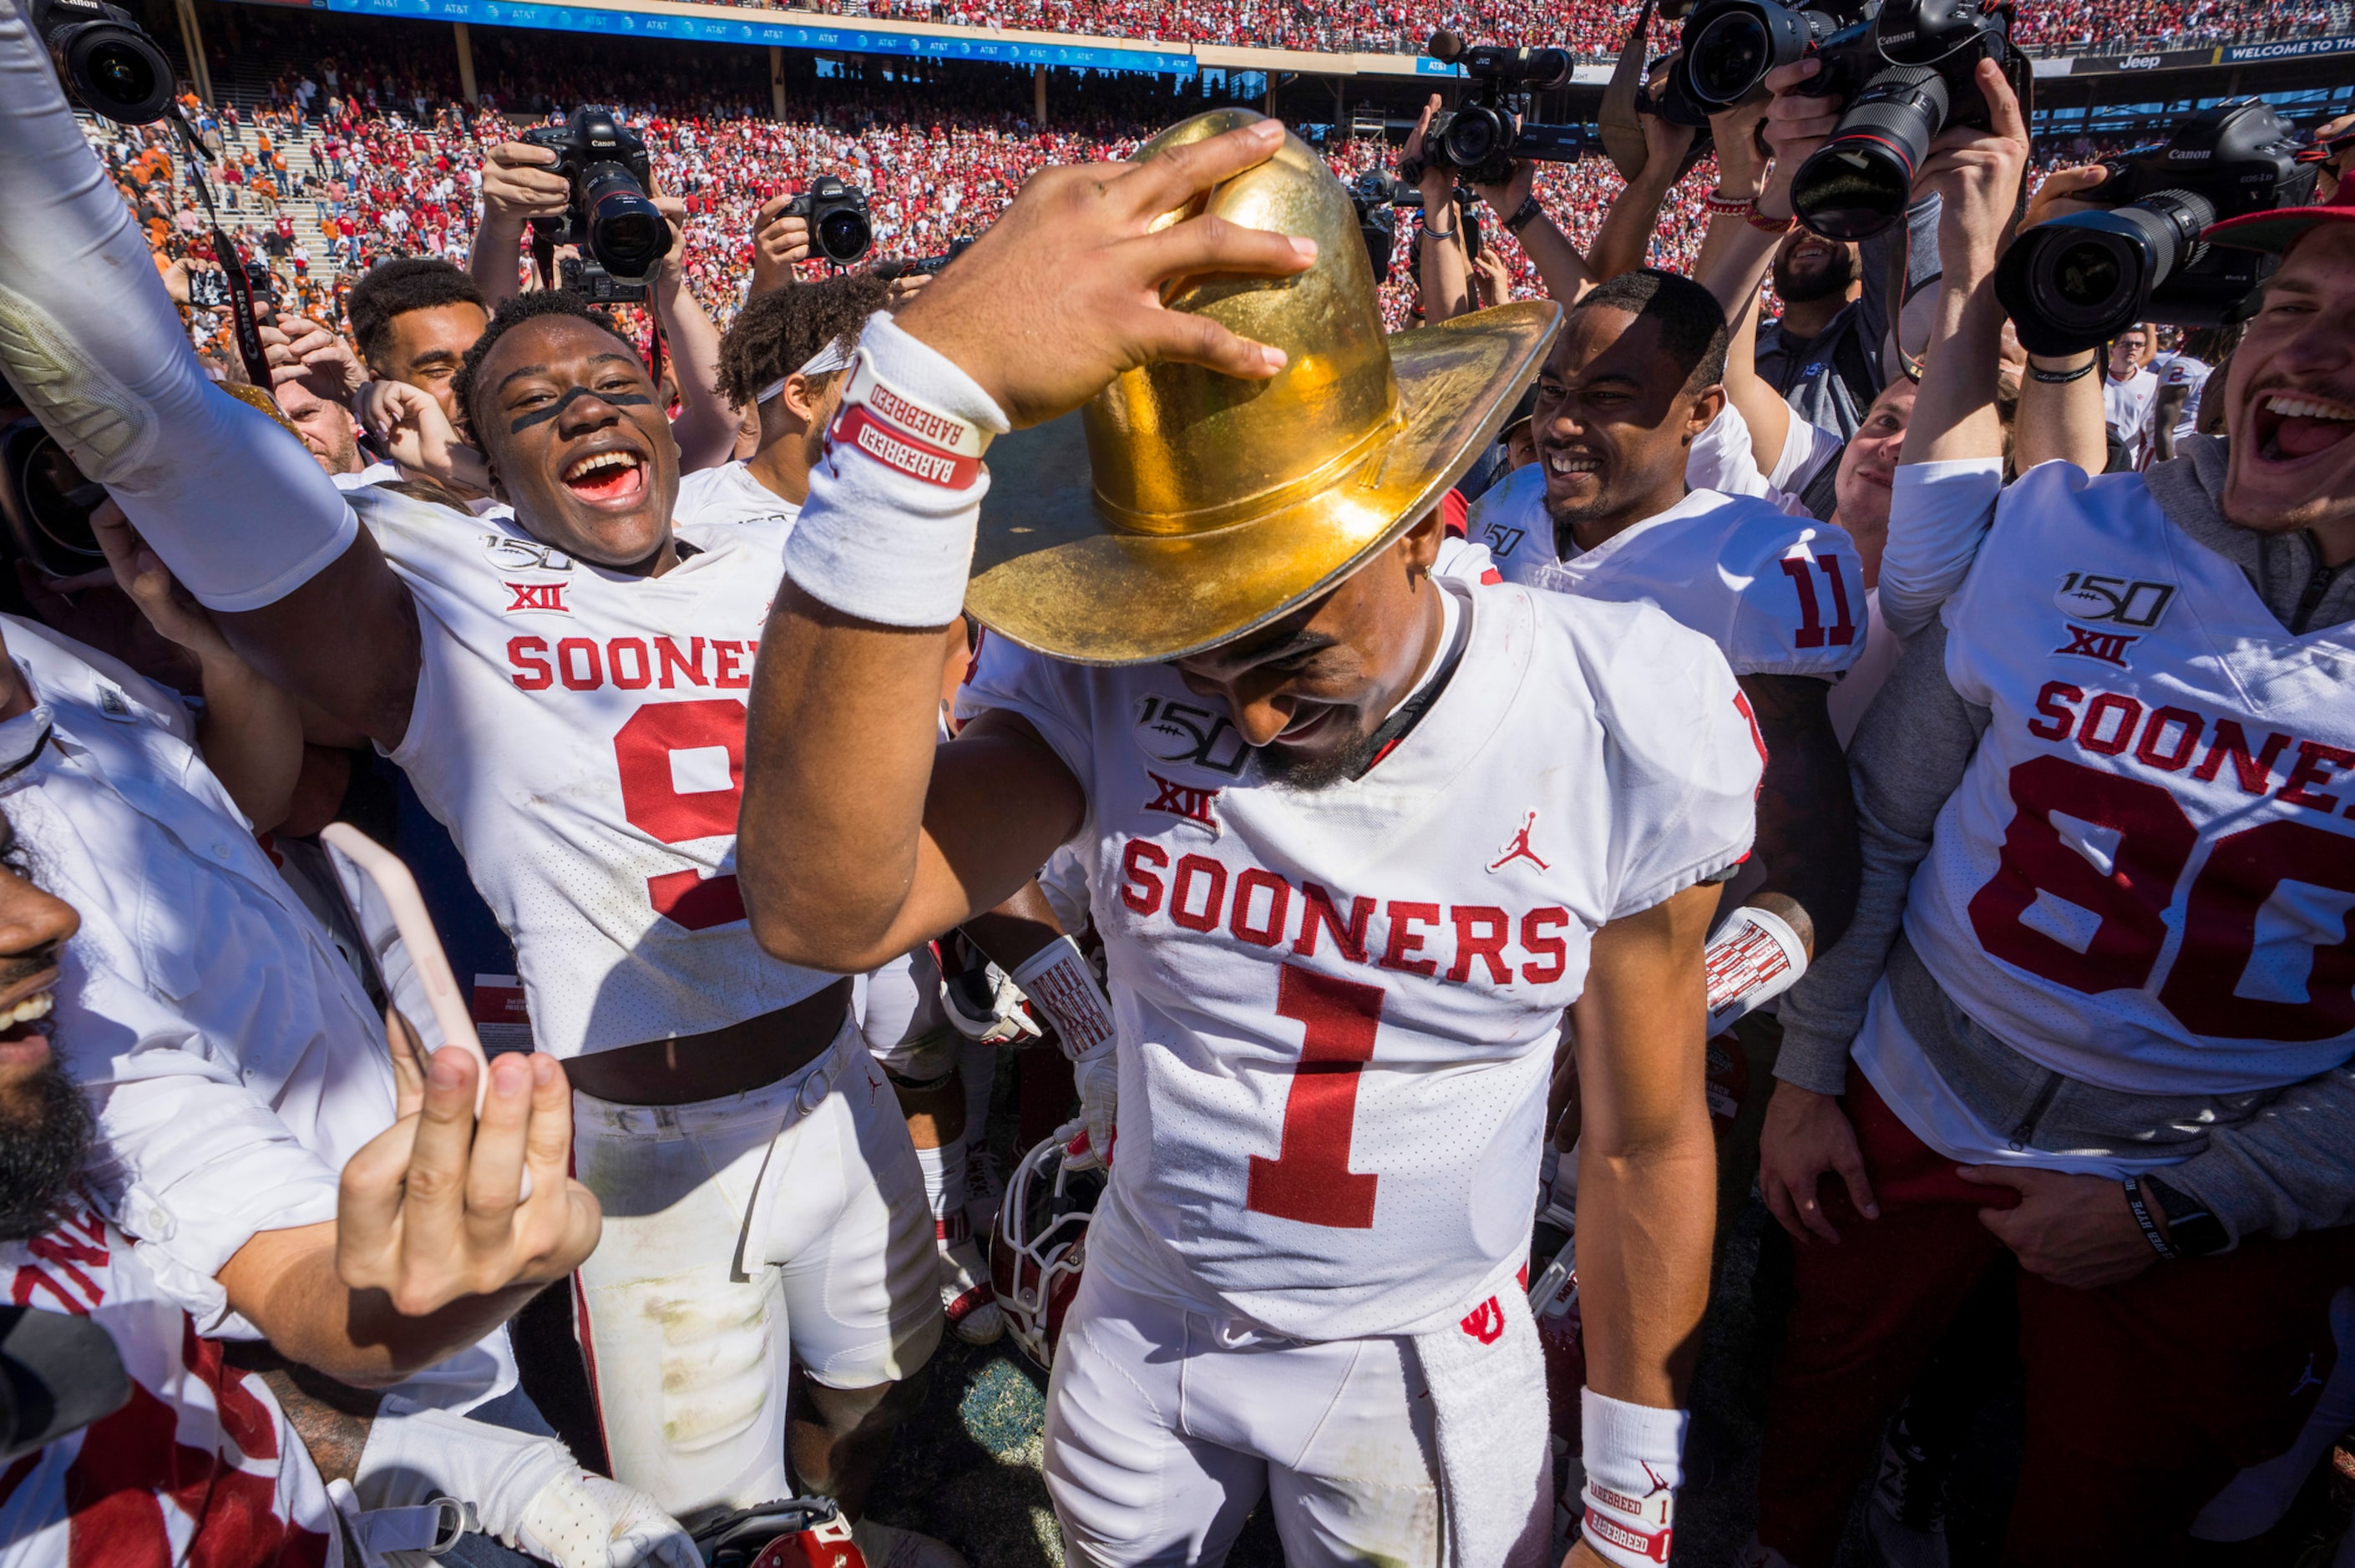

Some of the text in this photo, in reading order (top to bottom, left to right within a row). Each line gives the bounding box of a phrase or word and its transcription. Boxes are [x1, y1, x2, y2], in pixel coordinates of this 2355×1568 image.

[444, 4, 469, 14] AT&T
[513, 9, 535, 19] AT&T
[646, 20, 667, 30] AT&T
[706, 25, 727, 34] AT&T
[763, 29, 783, 39] AT&T
[818, 33, 838, 43] AT&T
[1878, 30, 1916, 46] Canon
[878, 38, 897, 48] AT&T
[929, 42, 949, 51] AT&T
[980, 46, 998, 54] AT&T
[2231, 42, 2307, 60] WELCOME
[2310, 39, 2332, 55] TO
[1029, 49, 1046, 58] AT&T
[1076, 53, 1094, 61] AT&T
[1476, 57, 1491, 65] JVC
[1172, 59, 1189, 68] AT&T
[1428, 59, 1447, 71] AT&T
[2119, 54, 2160, 70] Jeep
[592, 139, 616, 147] Canon
[2168, 149, 2211, 160] Canon
[236, 289, 260, 362] Canon
[2168, 366, 2185, 382] 2
[1482, 522, 1525, 557] 150
[482, 534, 576, 572] 150
[504, 580, 570, 612] XII
[1779, 554, 1856, 649] 11
[2059, 572, 2175, 627] 150
[2054, 624, 2140, 668] XII
[505, 635, 759, 691] SOONE
[1137, 696, 1253, 776] 150
[2027, 680, 2355, 818] SOONE
[1144, 769, 1221, 829] XII
[1121, 837, 1570, 984] SOONERS
[1247, 962, 1385, 1229] 1
[2130, 1200, 2154, 1229] HYPE
[1659, 1499, 1668, 1525] 1
[1660, 1533, 1669, 1561] 1
